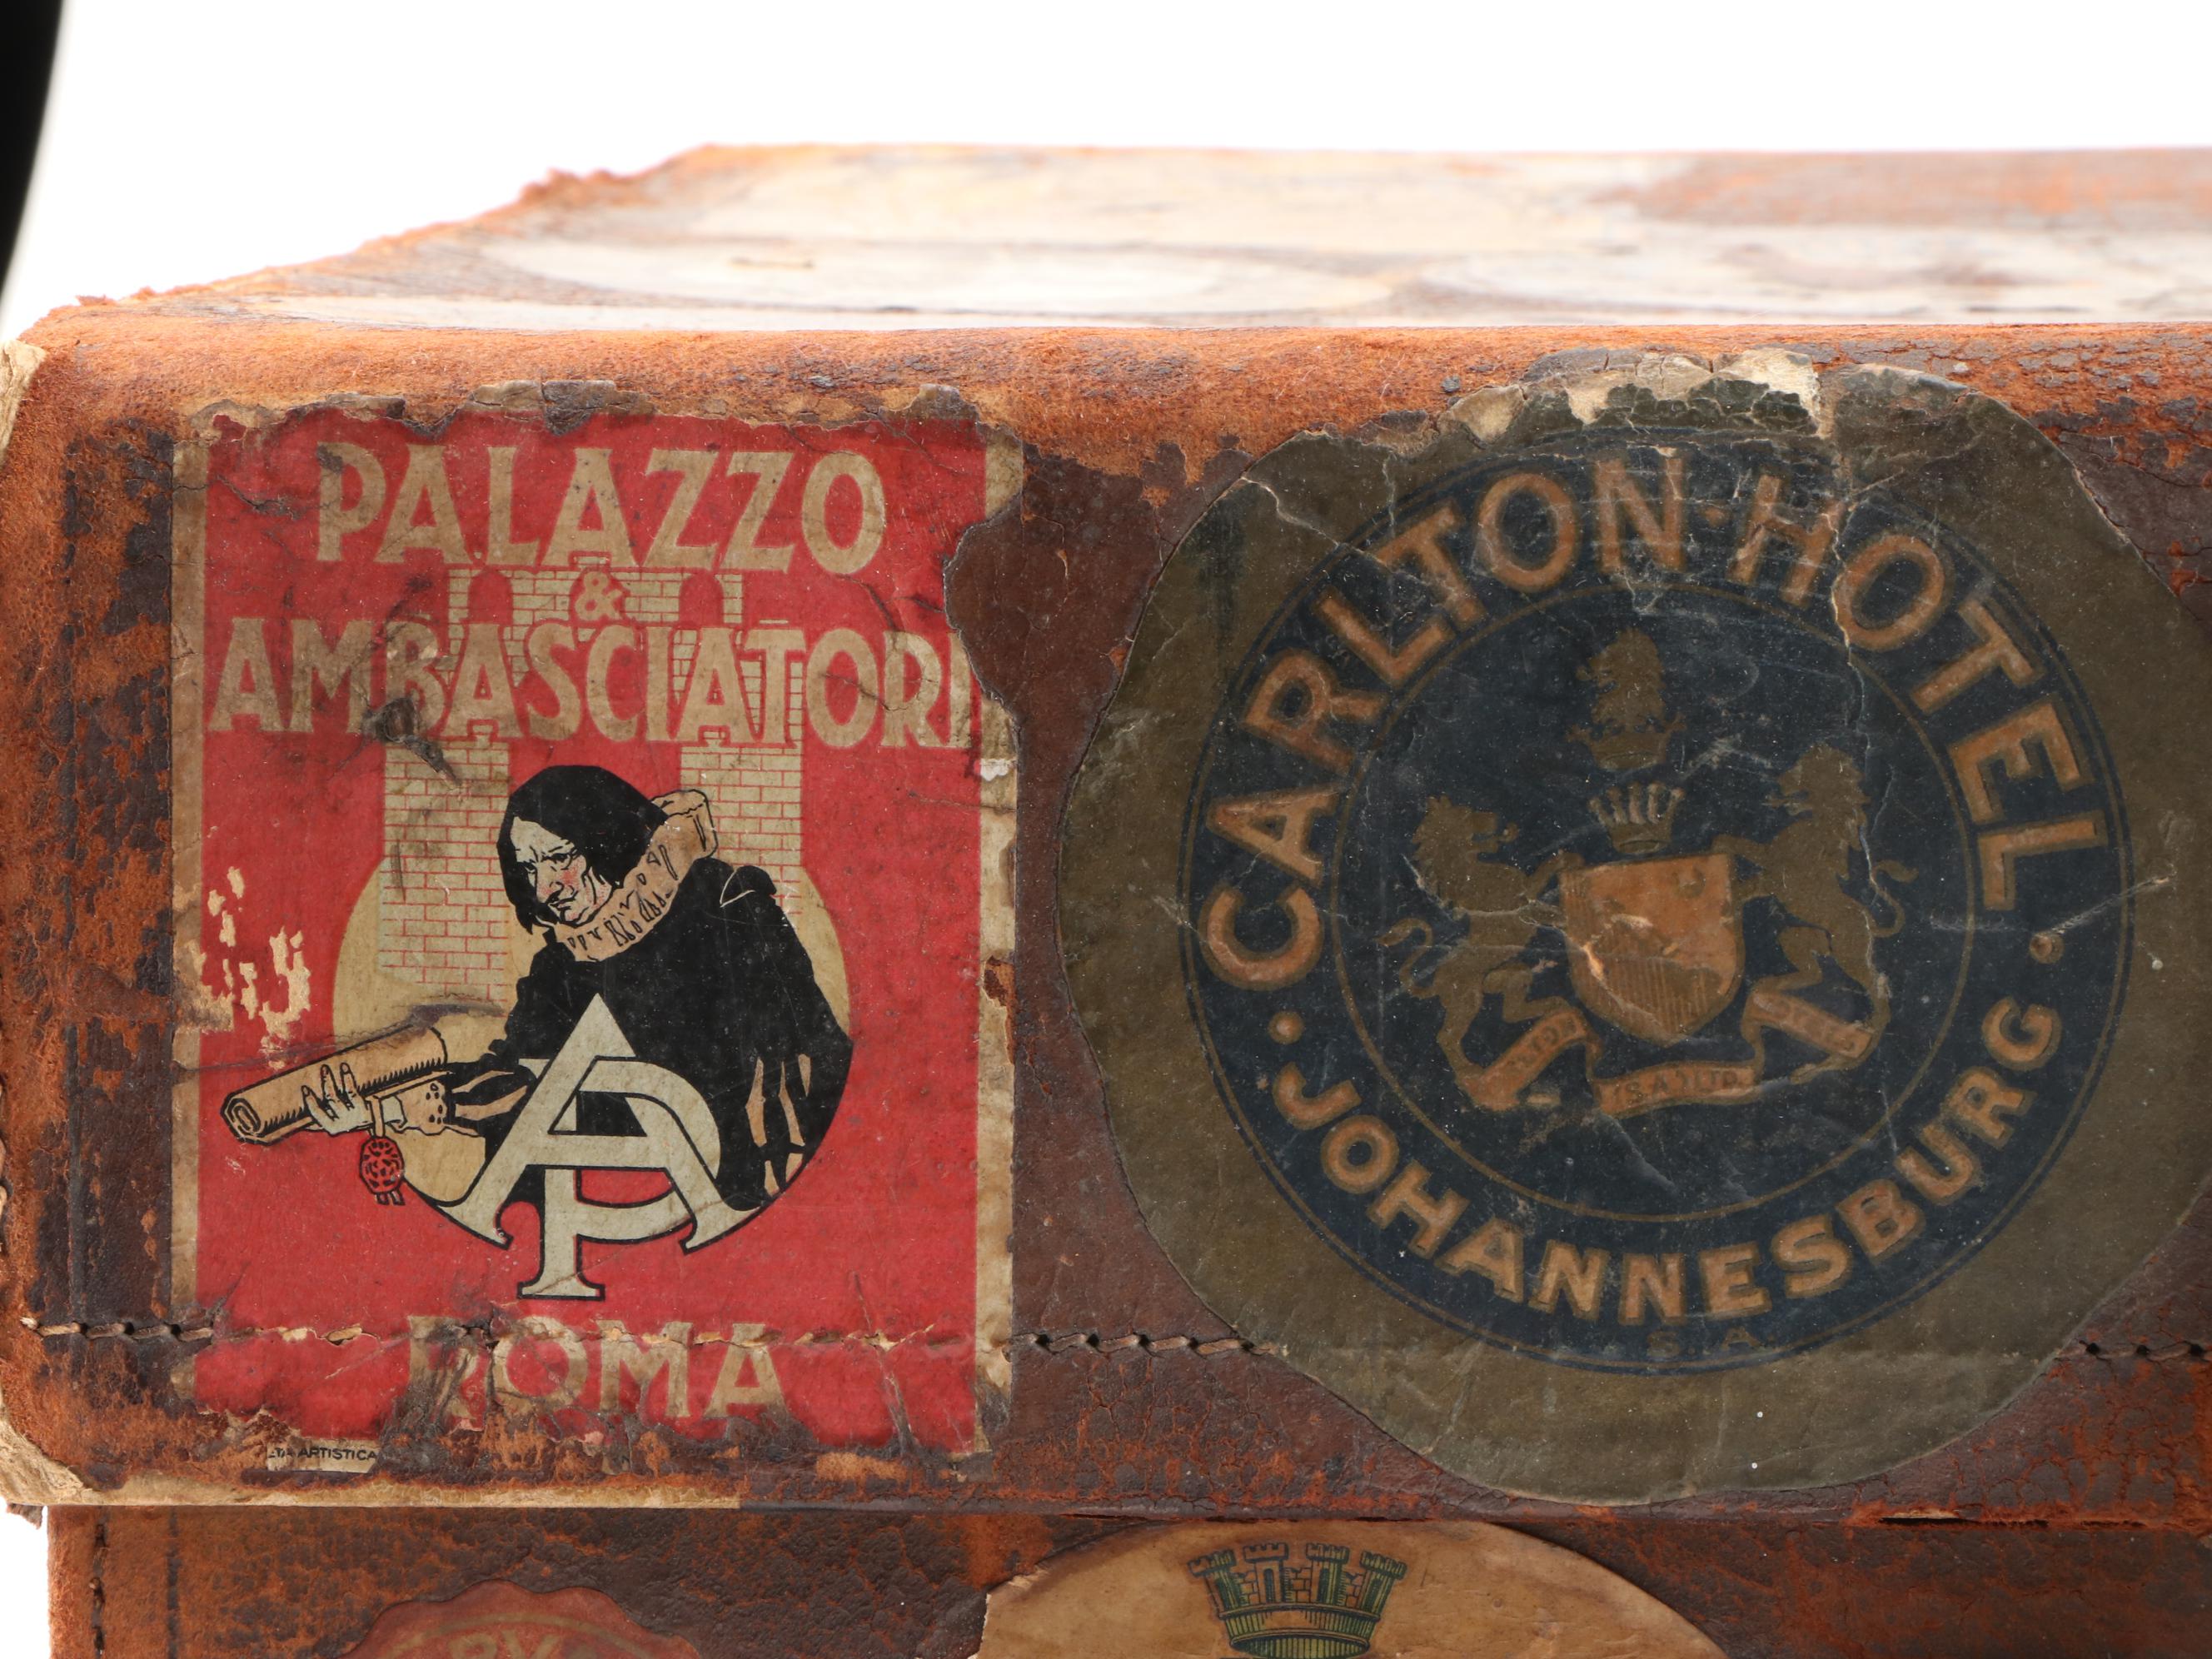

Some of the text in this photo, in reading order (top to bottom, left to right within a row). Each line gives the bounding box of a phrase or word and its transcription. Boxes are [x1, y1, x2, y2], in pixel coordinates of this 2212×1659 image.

[315, 441, 886, 575] PALAZZO
[571, 570, 625, 623] &
[208, 616, 973, 750] AMBASCIATORI
[1198, 448, 2110, 990] CARLTON HOTEL
[1271, 996, 2063, 1325] JOHANNESBURG
[408, 1314, 788, 1418] ROMA
[296, 1446, 378, 1462] ARTISTICA
